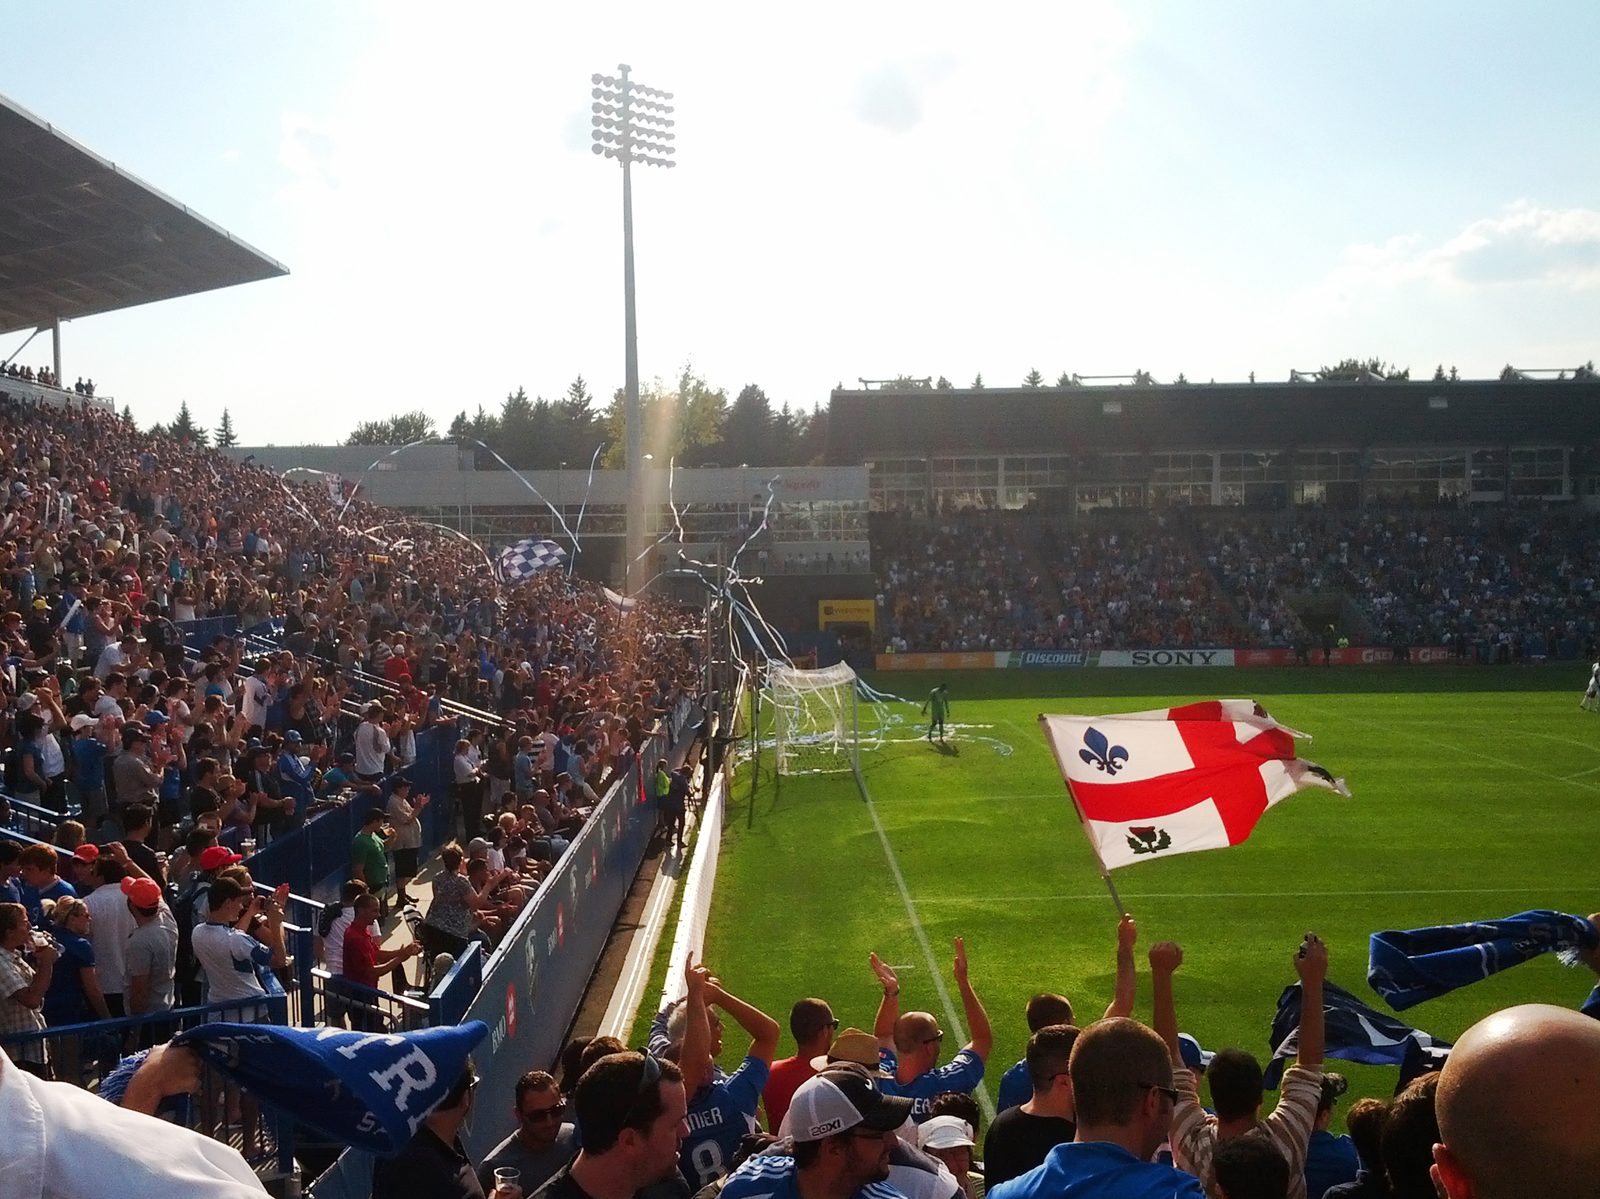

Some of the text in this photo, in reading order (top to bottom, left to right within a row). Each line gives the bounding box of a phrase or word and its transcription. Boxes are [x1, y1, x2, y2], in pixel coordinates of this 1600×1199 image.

[1131, 651, 1217, 665] SONY
[491, 1015, 507, 1055] BMO
[911, 1098, 934, 1114] ER
